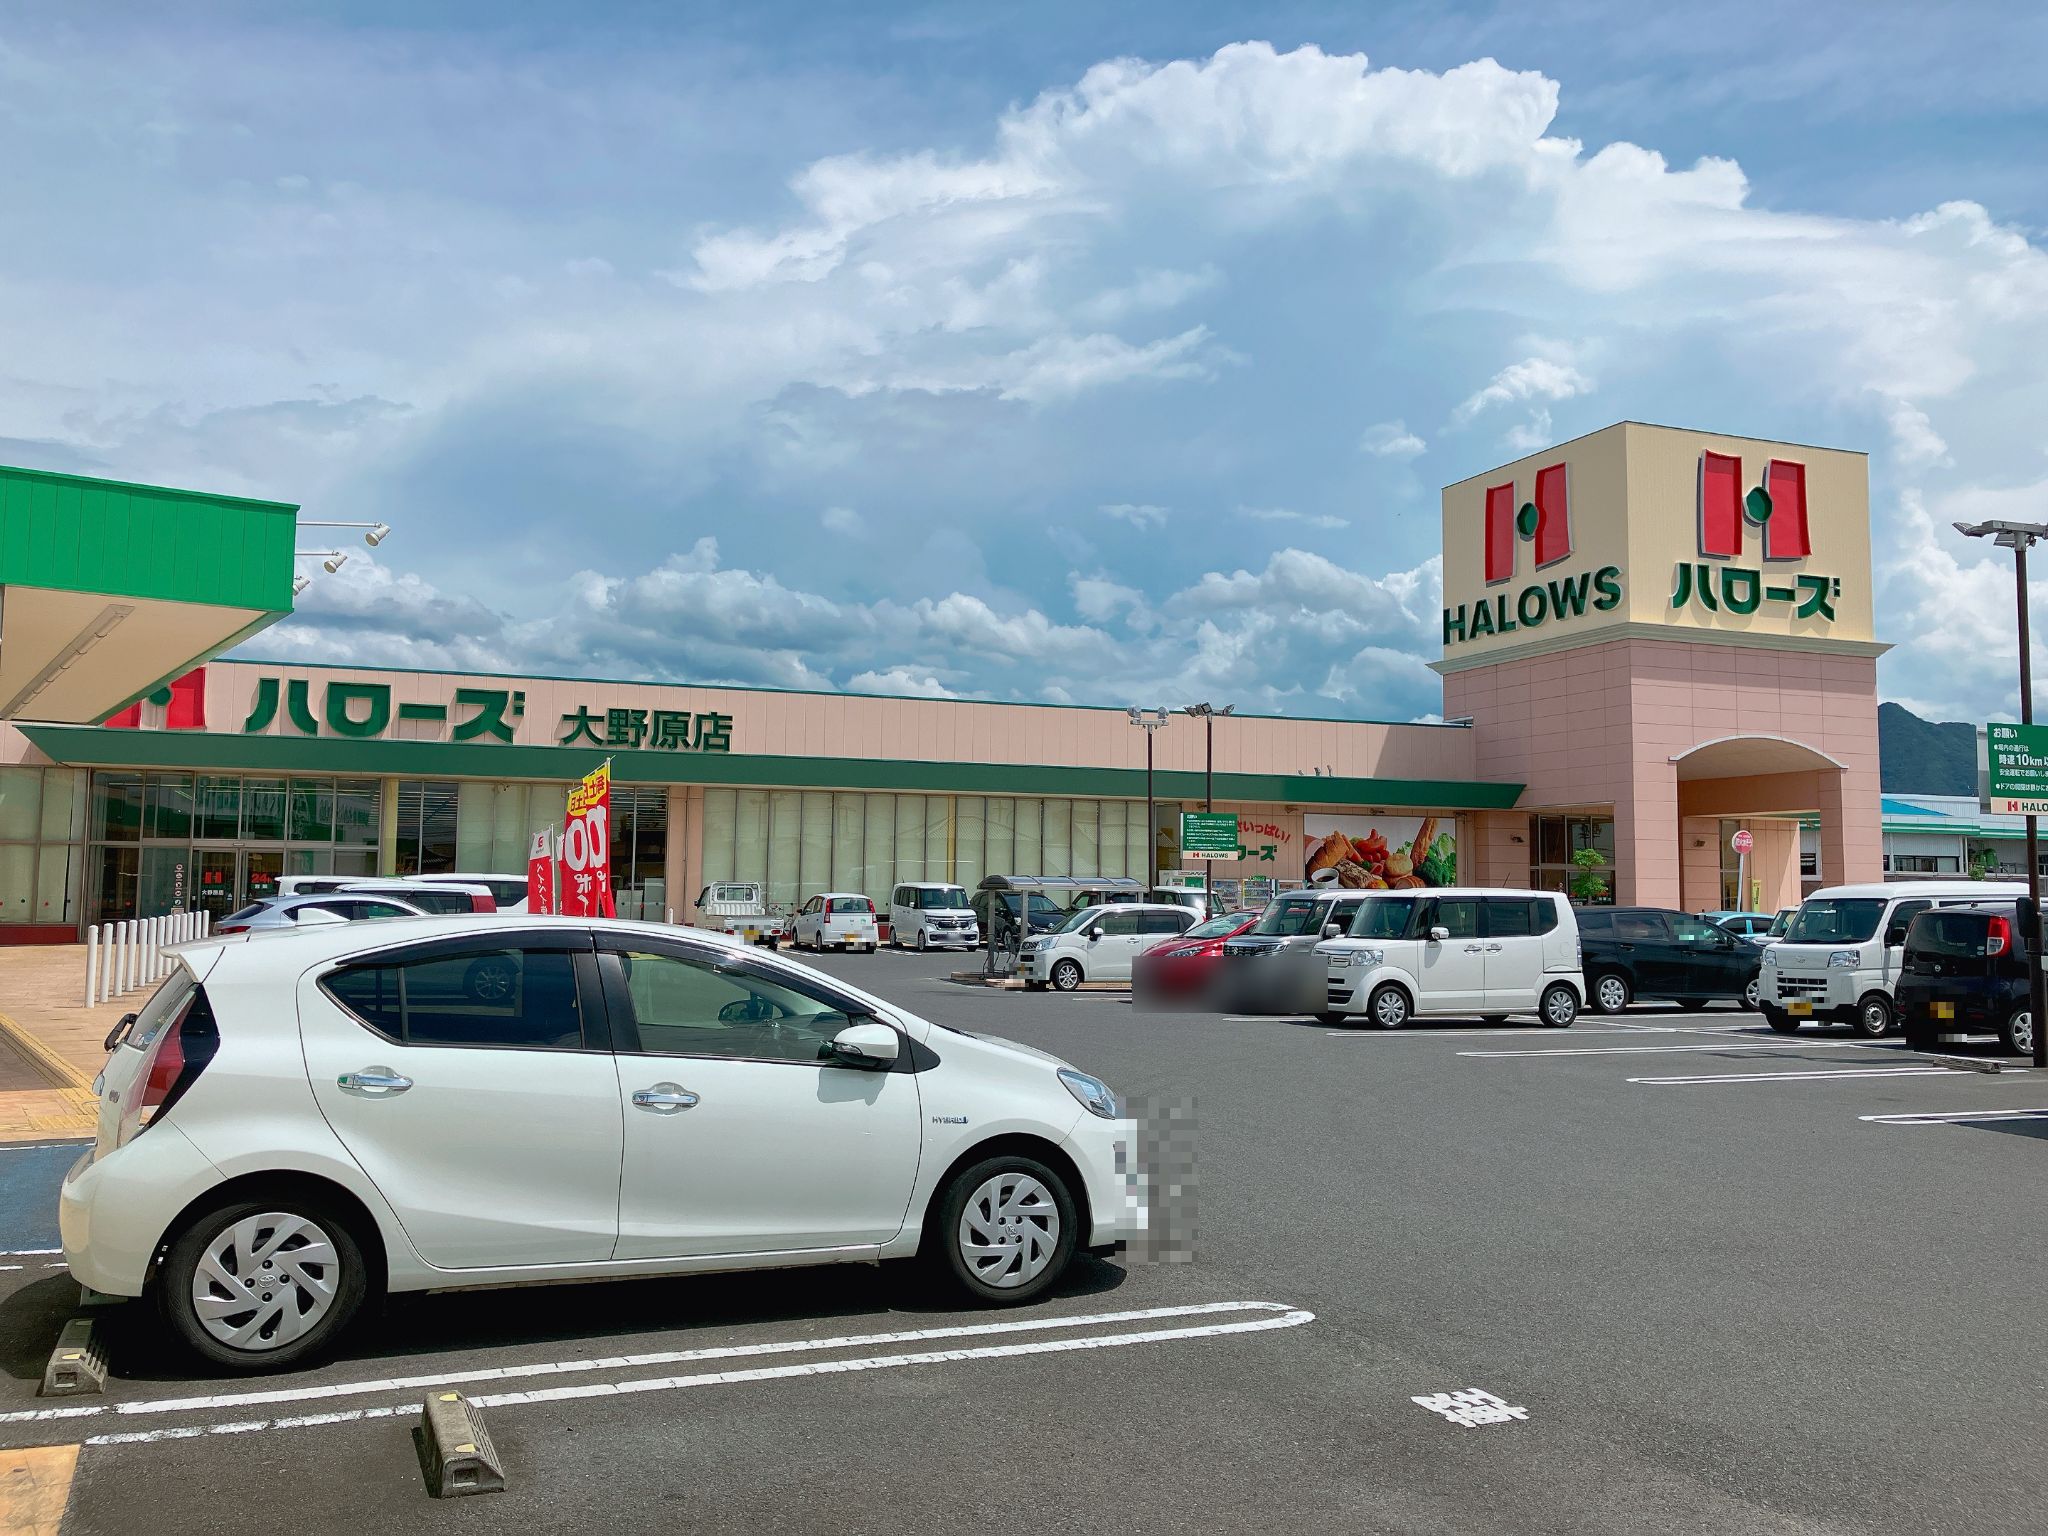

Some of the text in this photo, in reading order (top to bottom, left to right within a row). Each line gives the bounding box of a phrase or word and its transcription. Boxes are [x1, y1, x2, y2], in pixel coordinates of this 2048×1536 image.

[1443, 566, 1623, 645] HALOWS
[1671, 561, 1841, 622] ハローズ
[245, 677, 733, 751] ハローズ 大野原店
[1201, 851, 1229, 859] HALOWS
